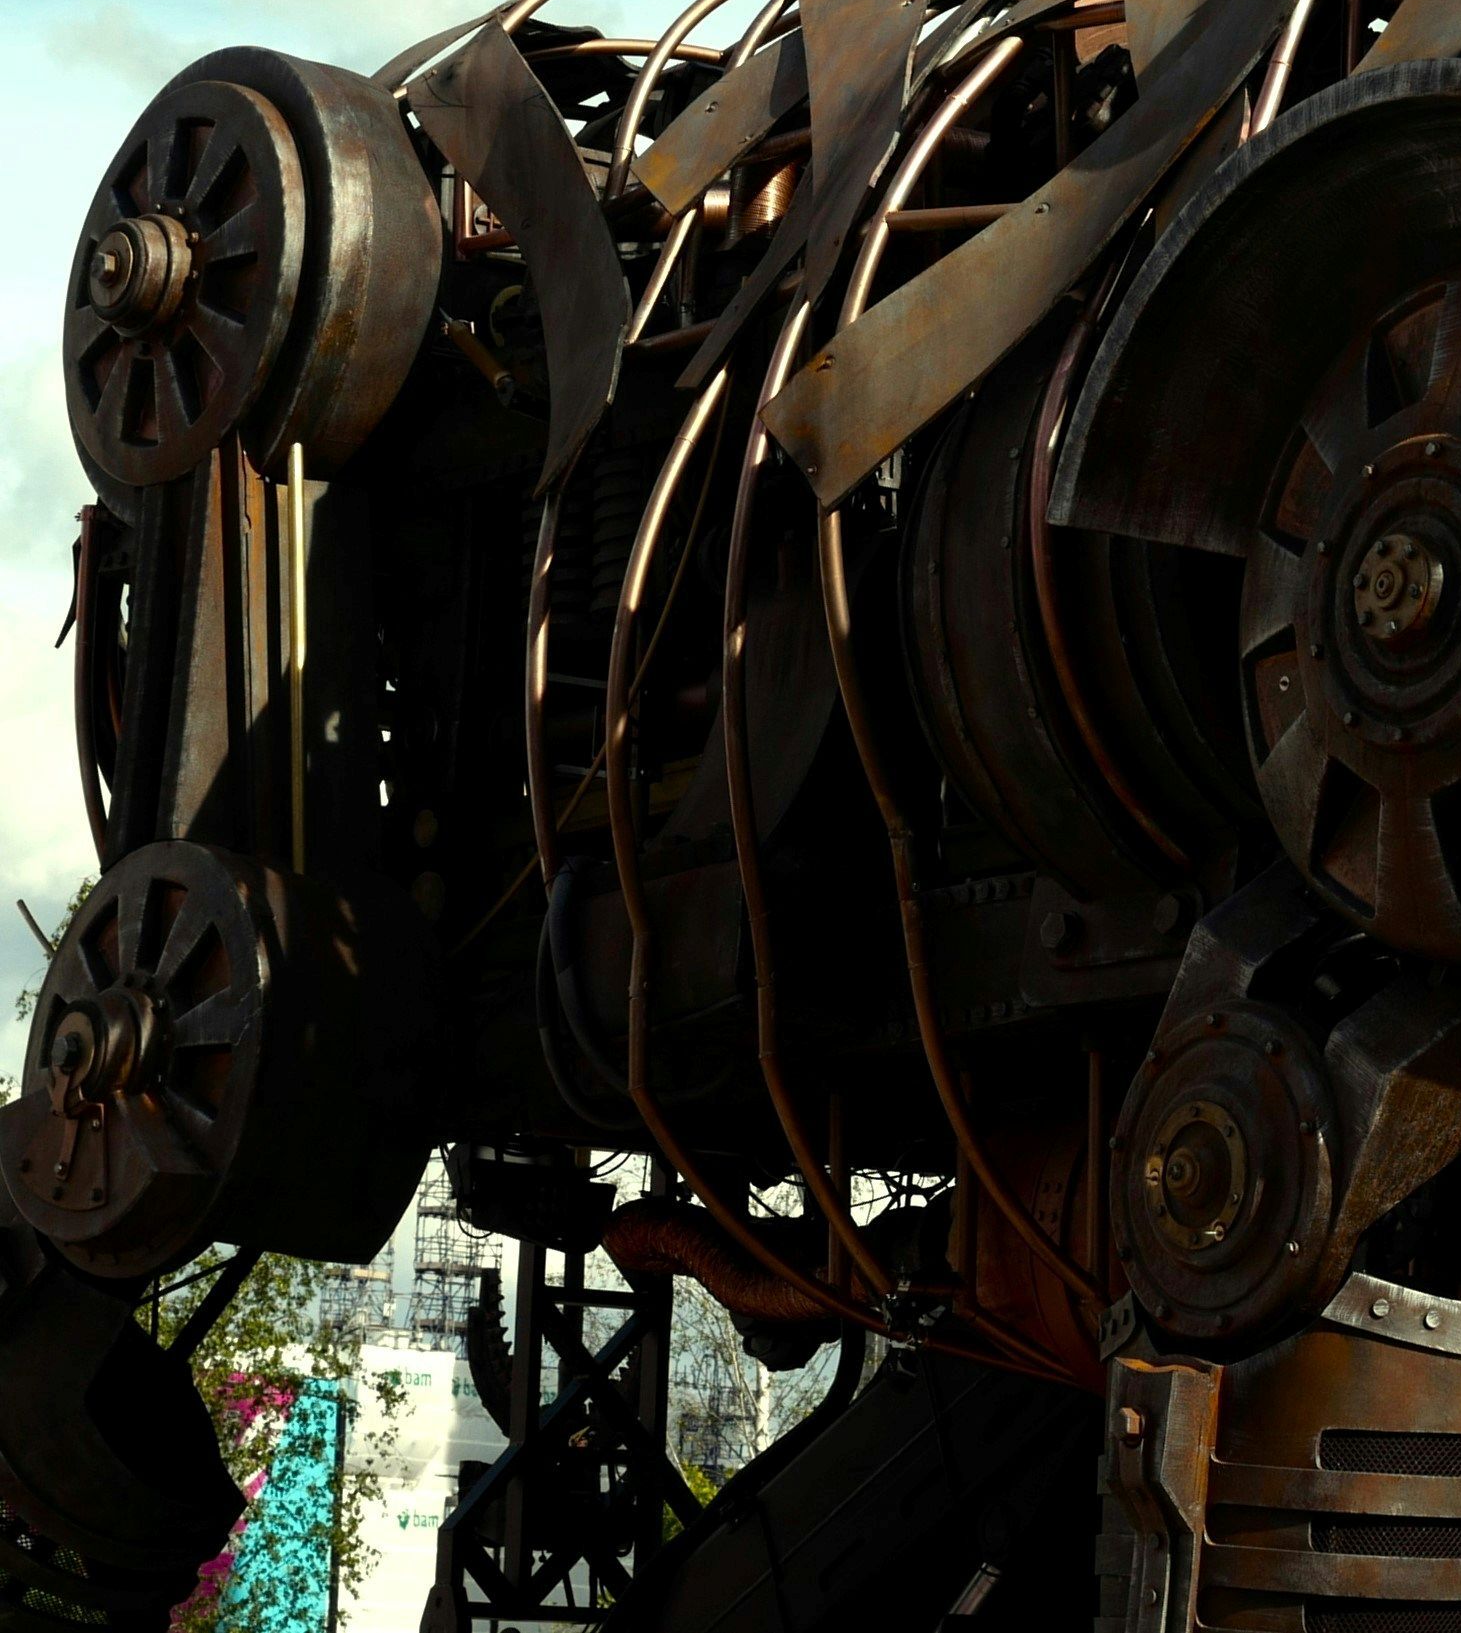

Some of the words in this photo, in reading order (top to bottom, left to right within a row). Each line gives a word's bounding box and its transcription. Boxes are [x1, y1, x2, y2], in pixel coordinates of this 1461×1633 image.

[405, 1367, 432, 1386] bam
[463, 1378, 479, 1398] ba
[413, 1509, 439, 1527] bam
